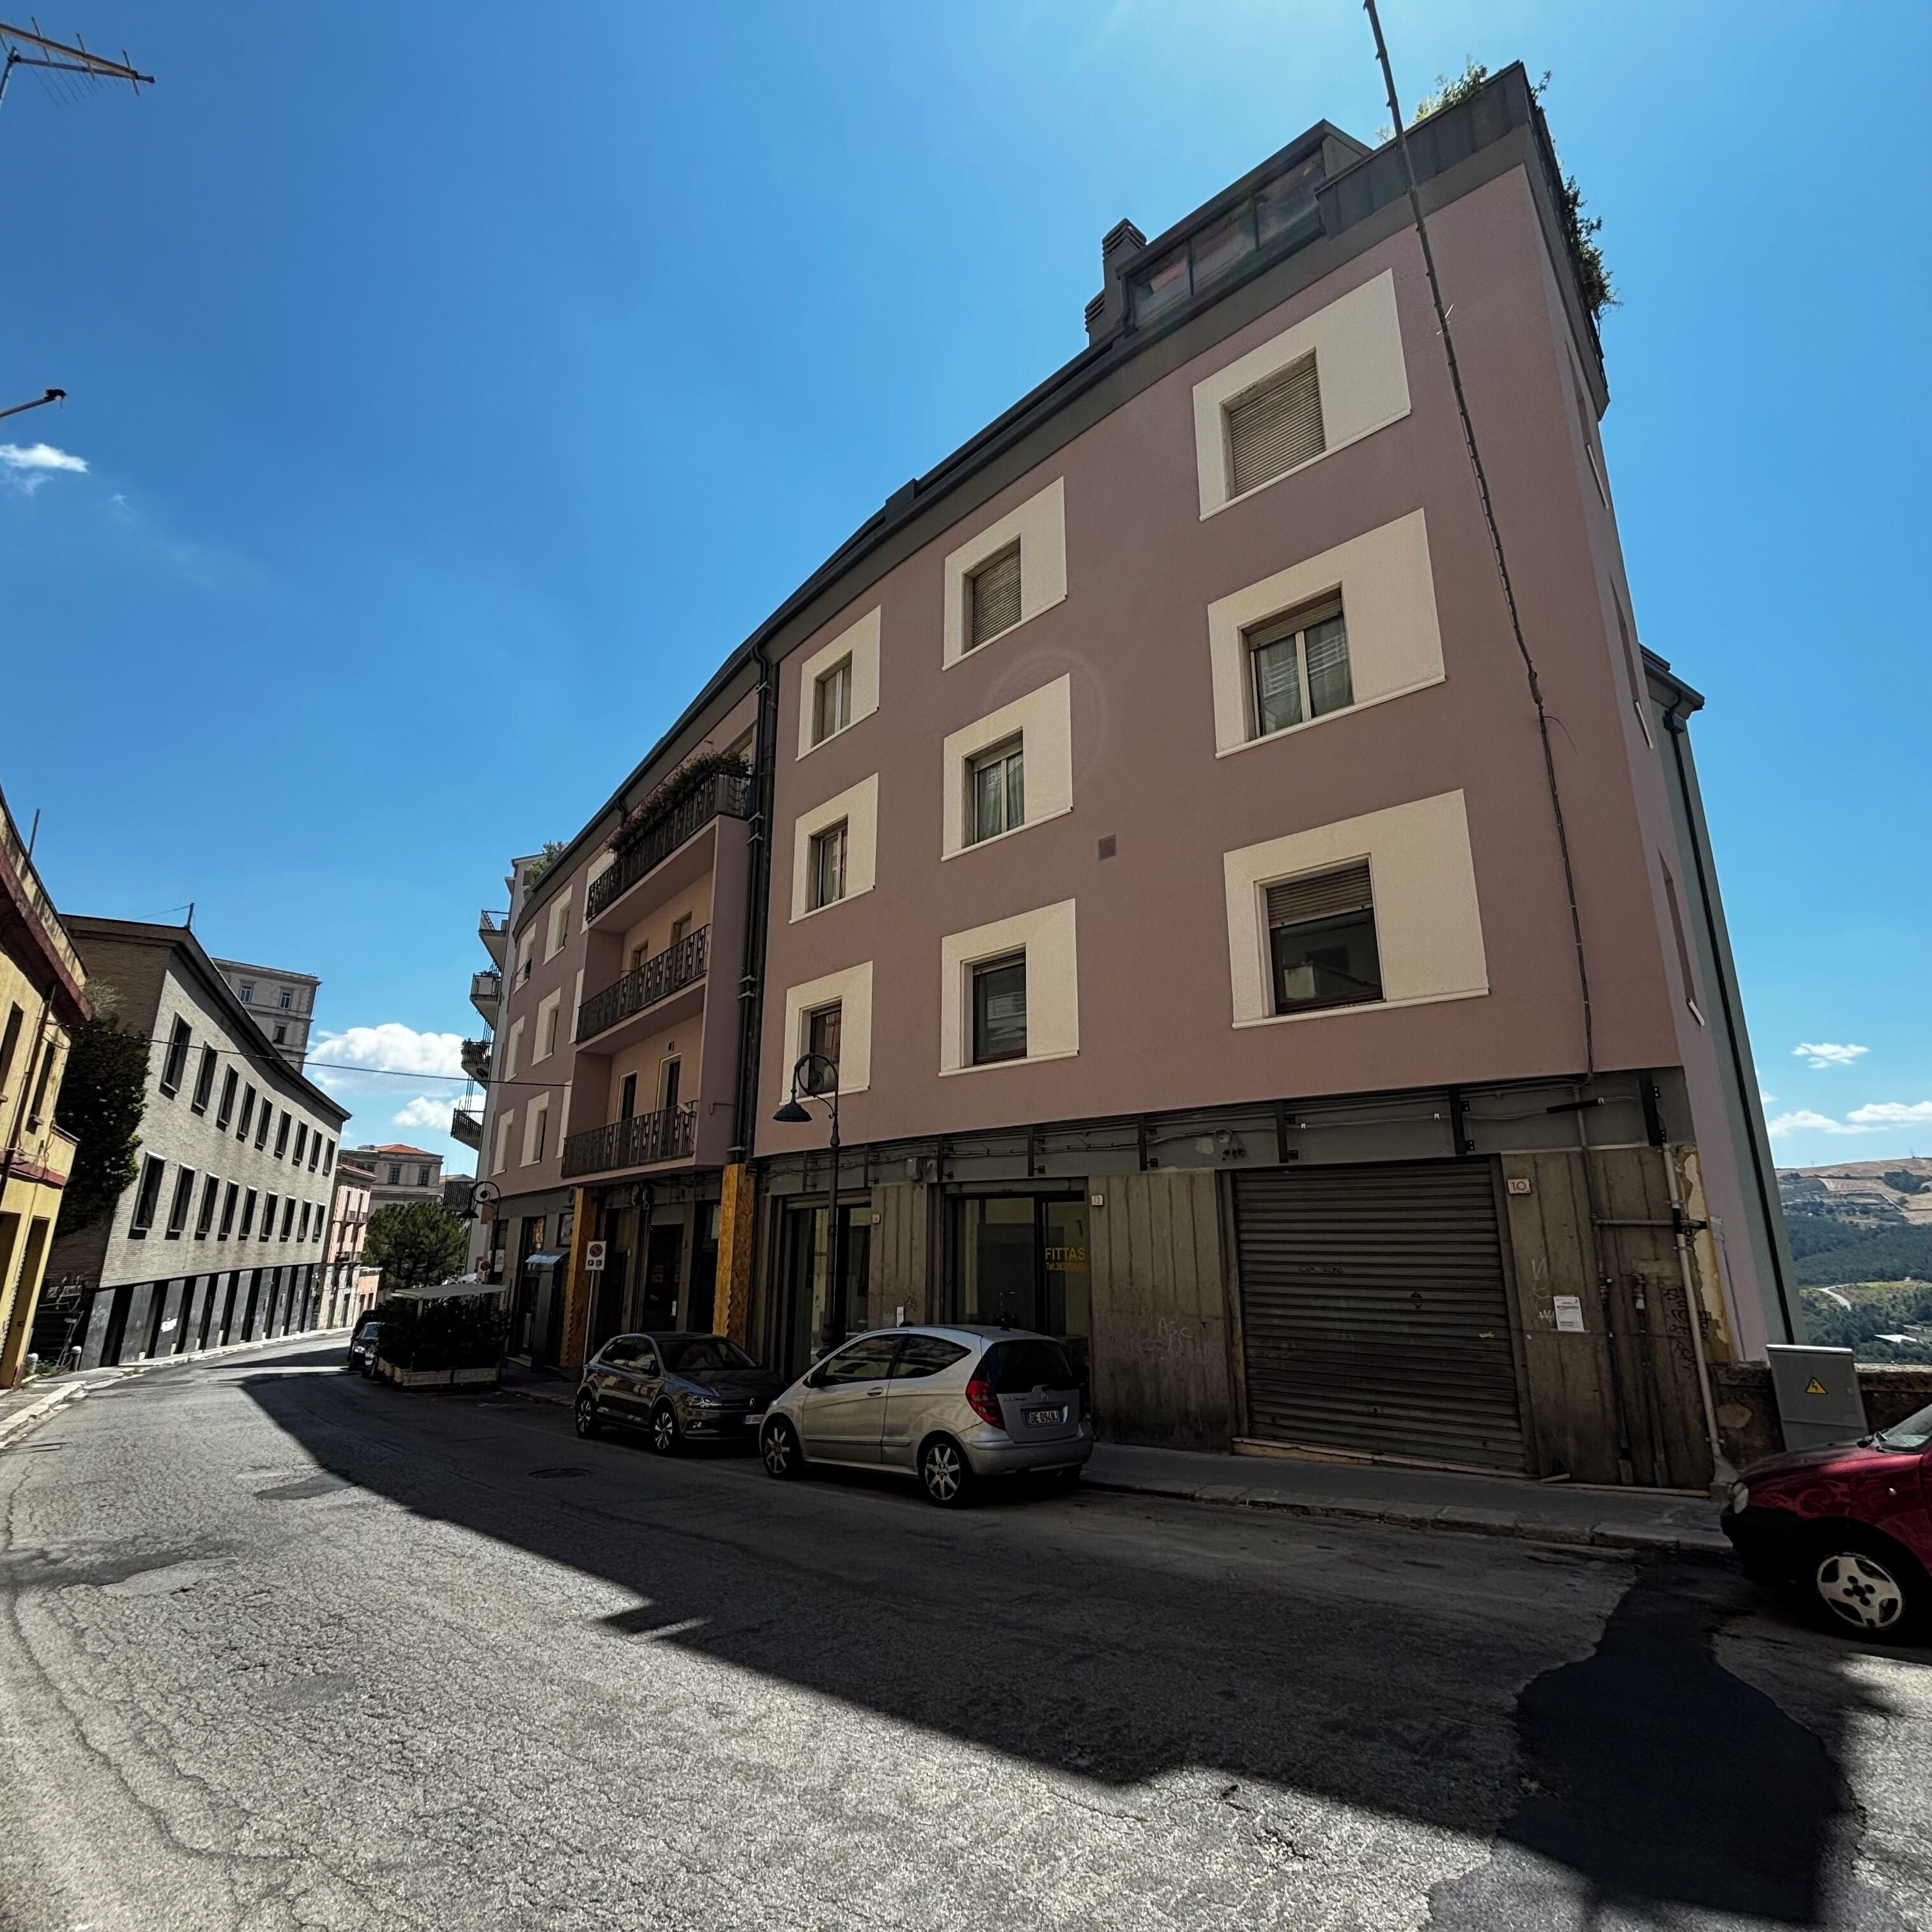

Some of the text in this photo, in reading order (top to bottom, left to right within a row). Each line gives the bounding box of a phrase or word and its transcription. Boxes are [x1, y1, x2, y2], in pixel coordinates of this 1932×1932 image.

[1511, 1181, 1527, 1192] 10
[1045, 1246, 1086, 1261] FITTAS
[1031, 1413, 1039, 1423] DE
